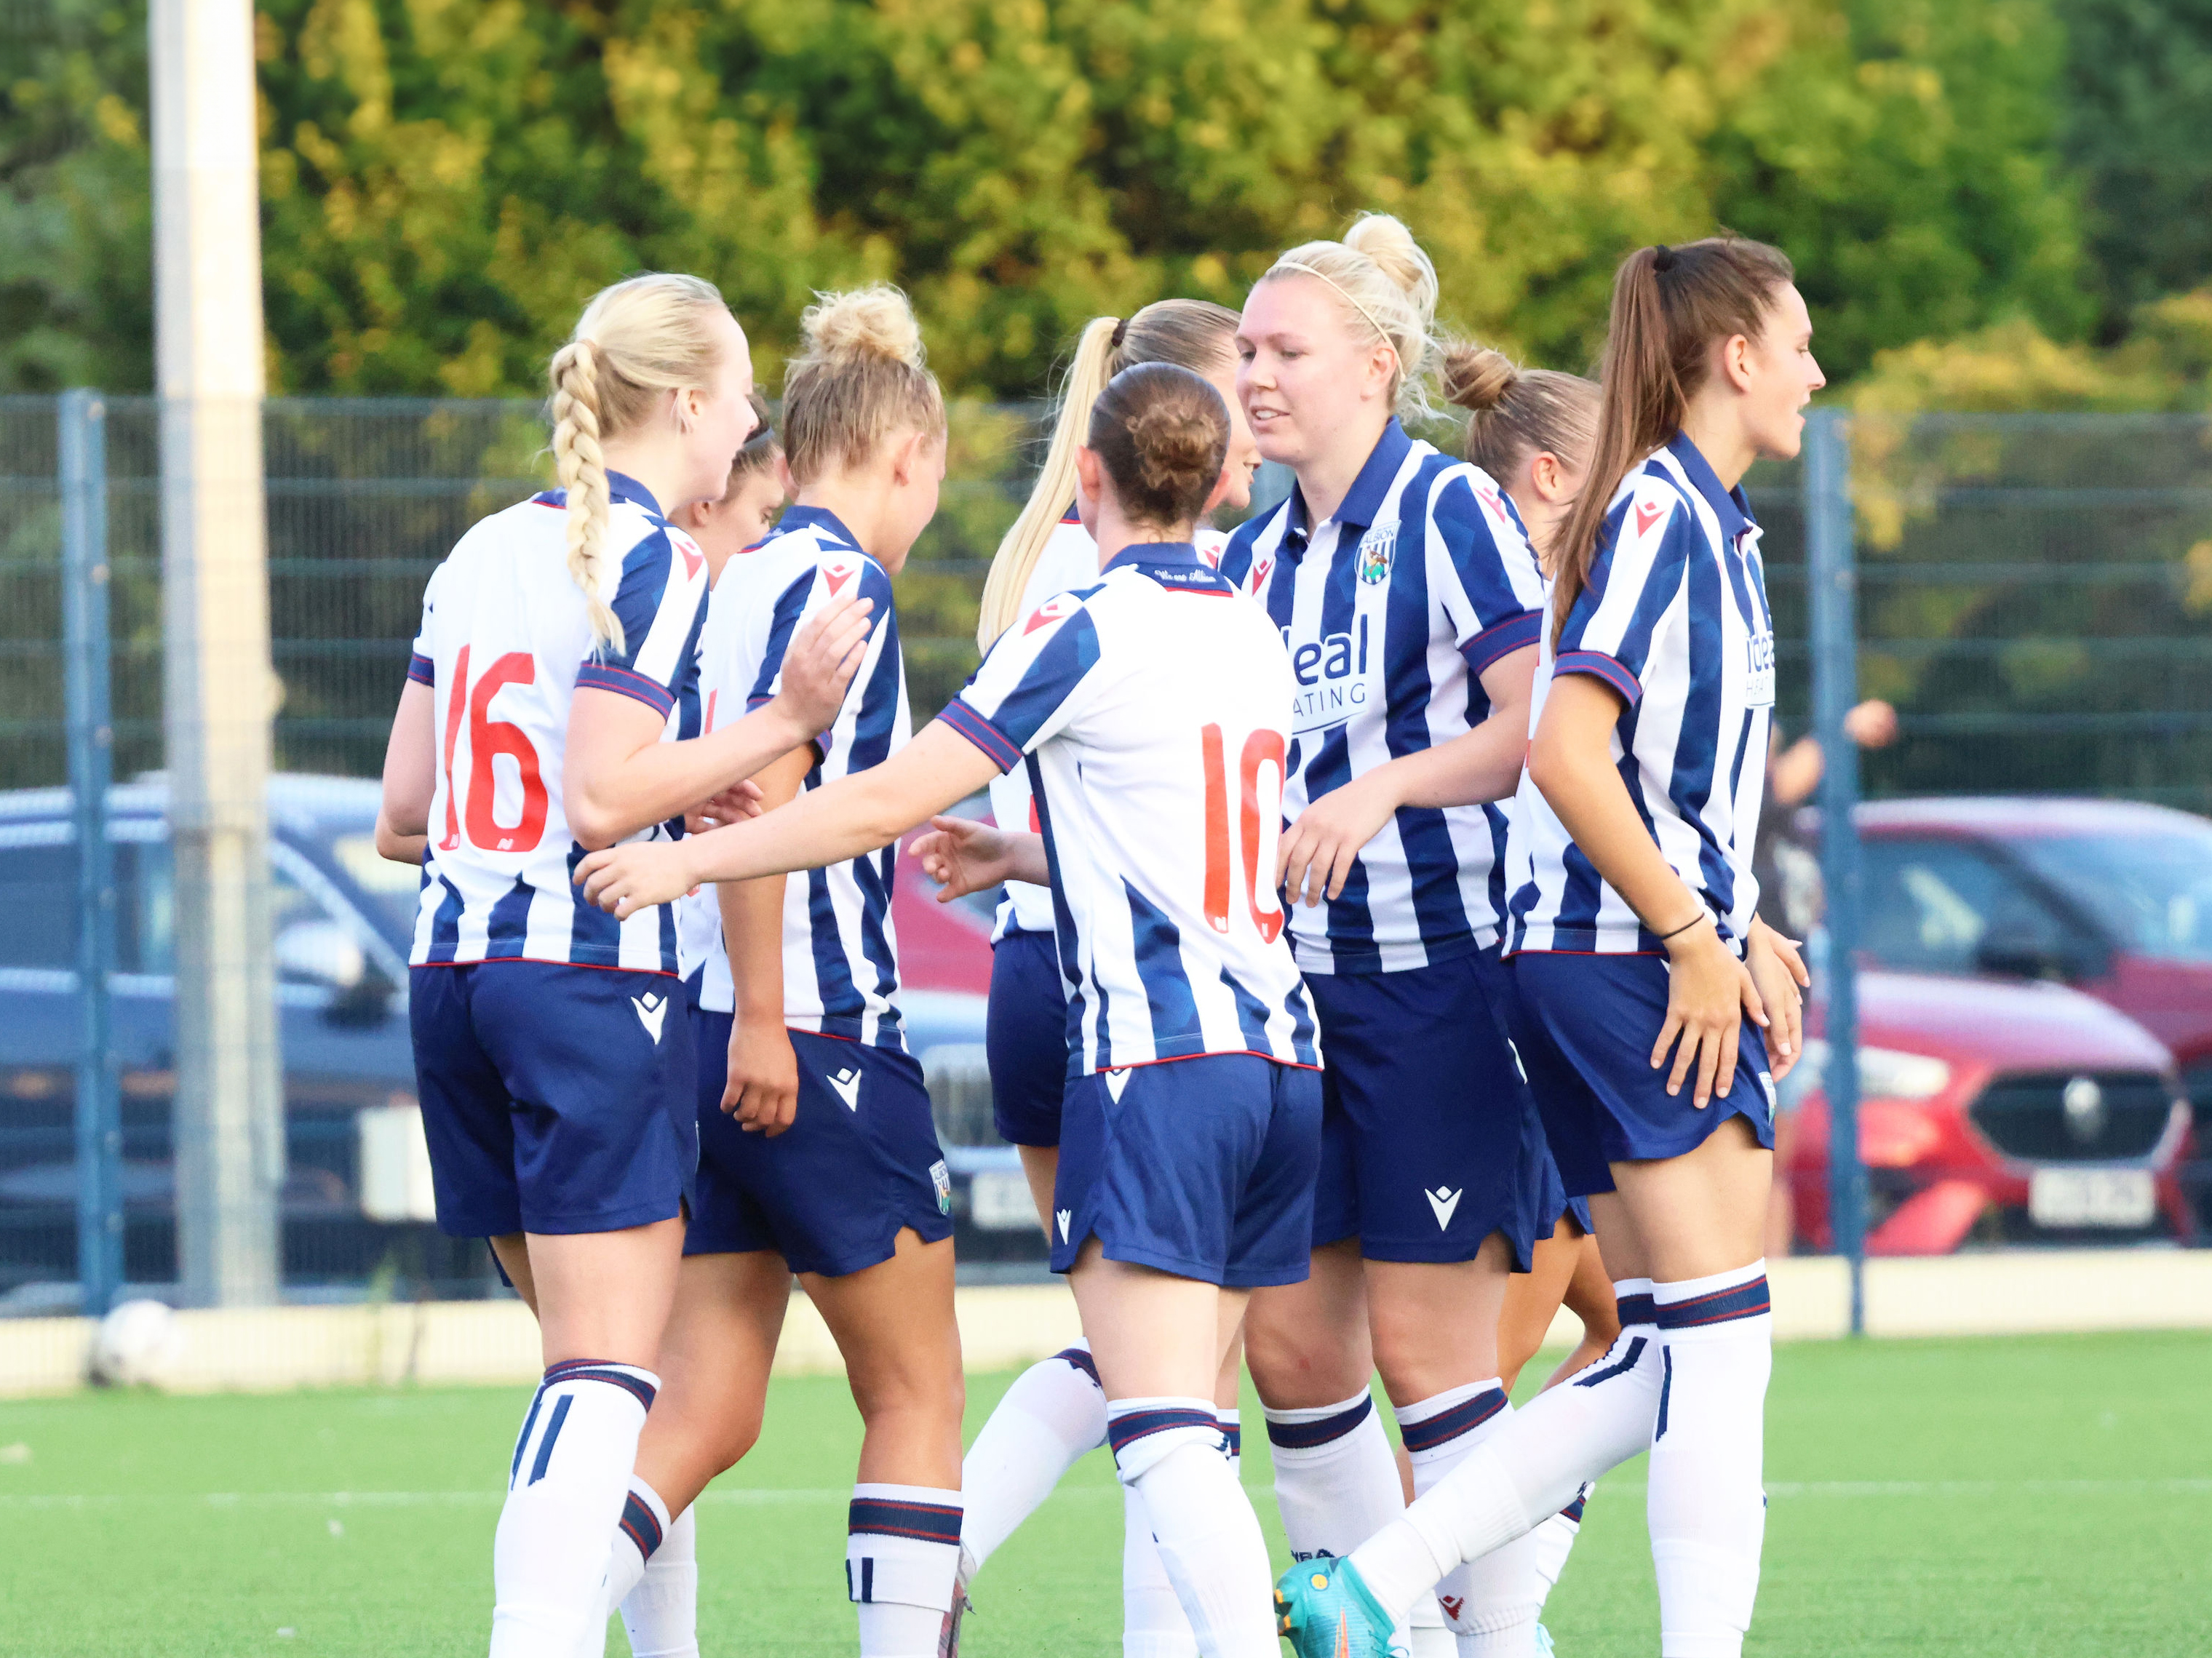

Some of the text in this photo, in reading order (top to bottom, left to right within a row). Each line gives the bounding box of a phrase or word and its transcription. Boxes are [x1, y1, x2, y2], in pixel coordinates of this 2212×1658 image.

[1362, 529, 1394, 544] ALBION
[1283, 613, 1368, 686] eal
[1293, 683, 1366, 717] ATING
[438, 644, 548, 853] 16
[1201, 722, 1286, 944] 10
